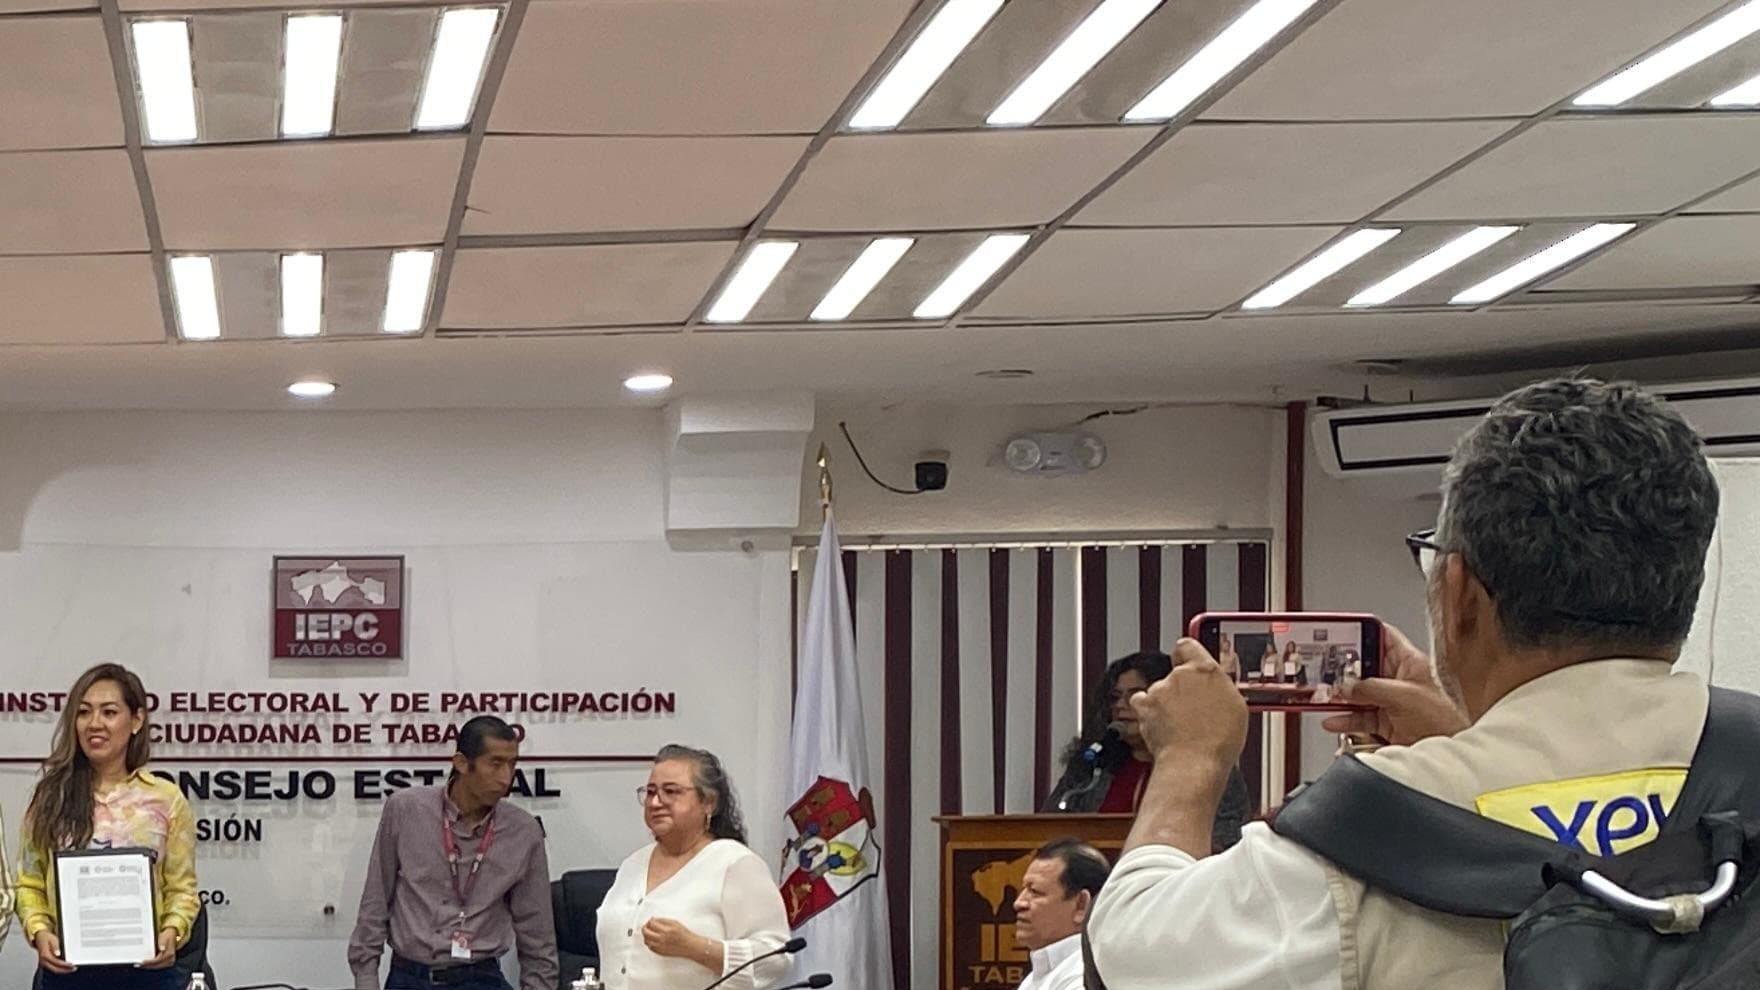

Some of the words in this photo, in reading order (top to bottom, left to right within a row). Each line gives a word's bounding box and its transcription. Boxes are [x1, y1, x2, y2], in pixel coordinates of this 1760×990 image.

[295, 612, 379, 641] IEPC
[287, 643, 387, 656] TABASCO
[170, 692, 349, 713] ELECTORAL
[359, 692, 381, 713] Y
[390, 692, 430, 713] DE
[440, 686, 676, 714] PARTICIPACIÓN
[148, 723, 321, 745] CIUDADANA
[332, 723, 372, 744] DE
[382, 723, 526, 744] TABAO
[196, 813, 262, 842] SIÓN
